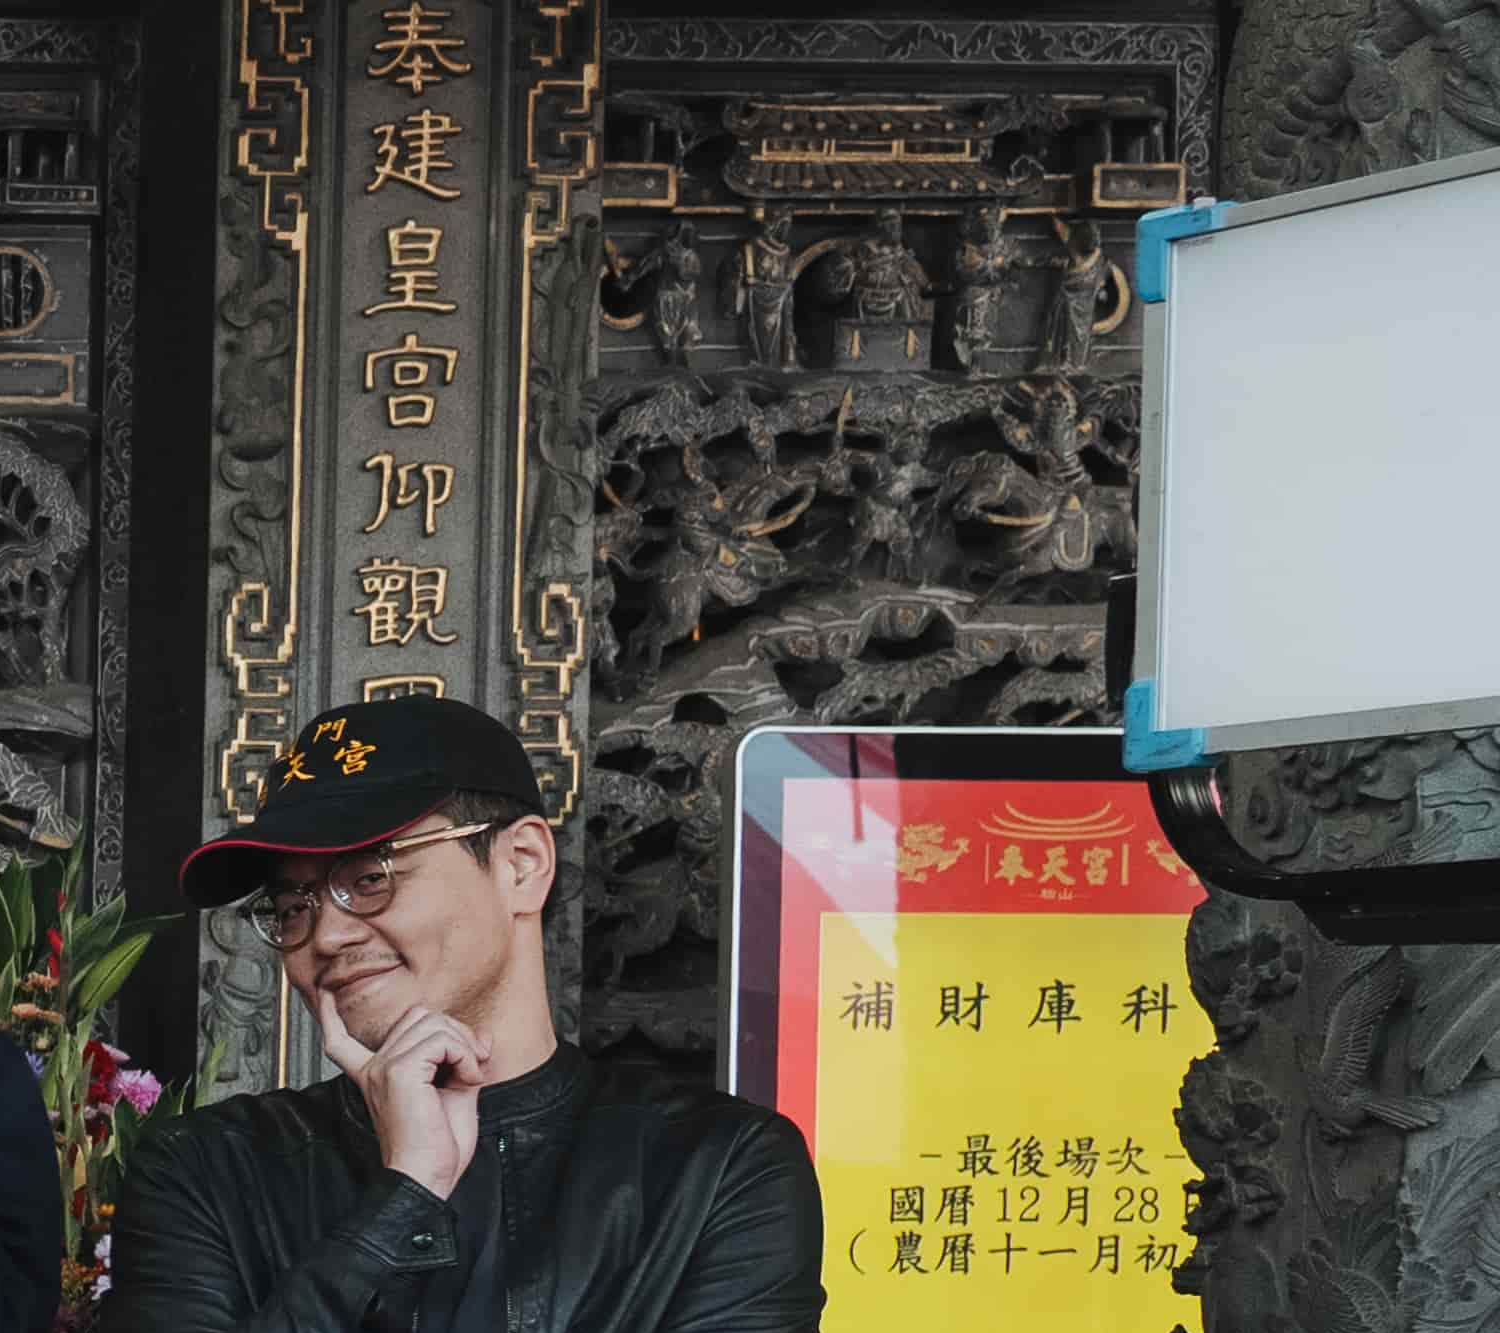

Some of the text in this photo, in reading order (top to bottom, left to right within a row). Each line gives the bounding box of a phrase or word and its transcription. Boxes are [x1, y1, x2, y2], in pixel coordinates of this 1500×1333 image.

[352, 2, 473, 703] 奉建皇宮仰觀
[992, 842, 1111, 888] 奉天宮
